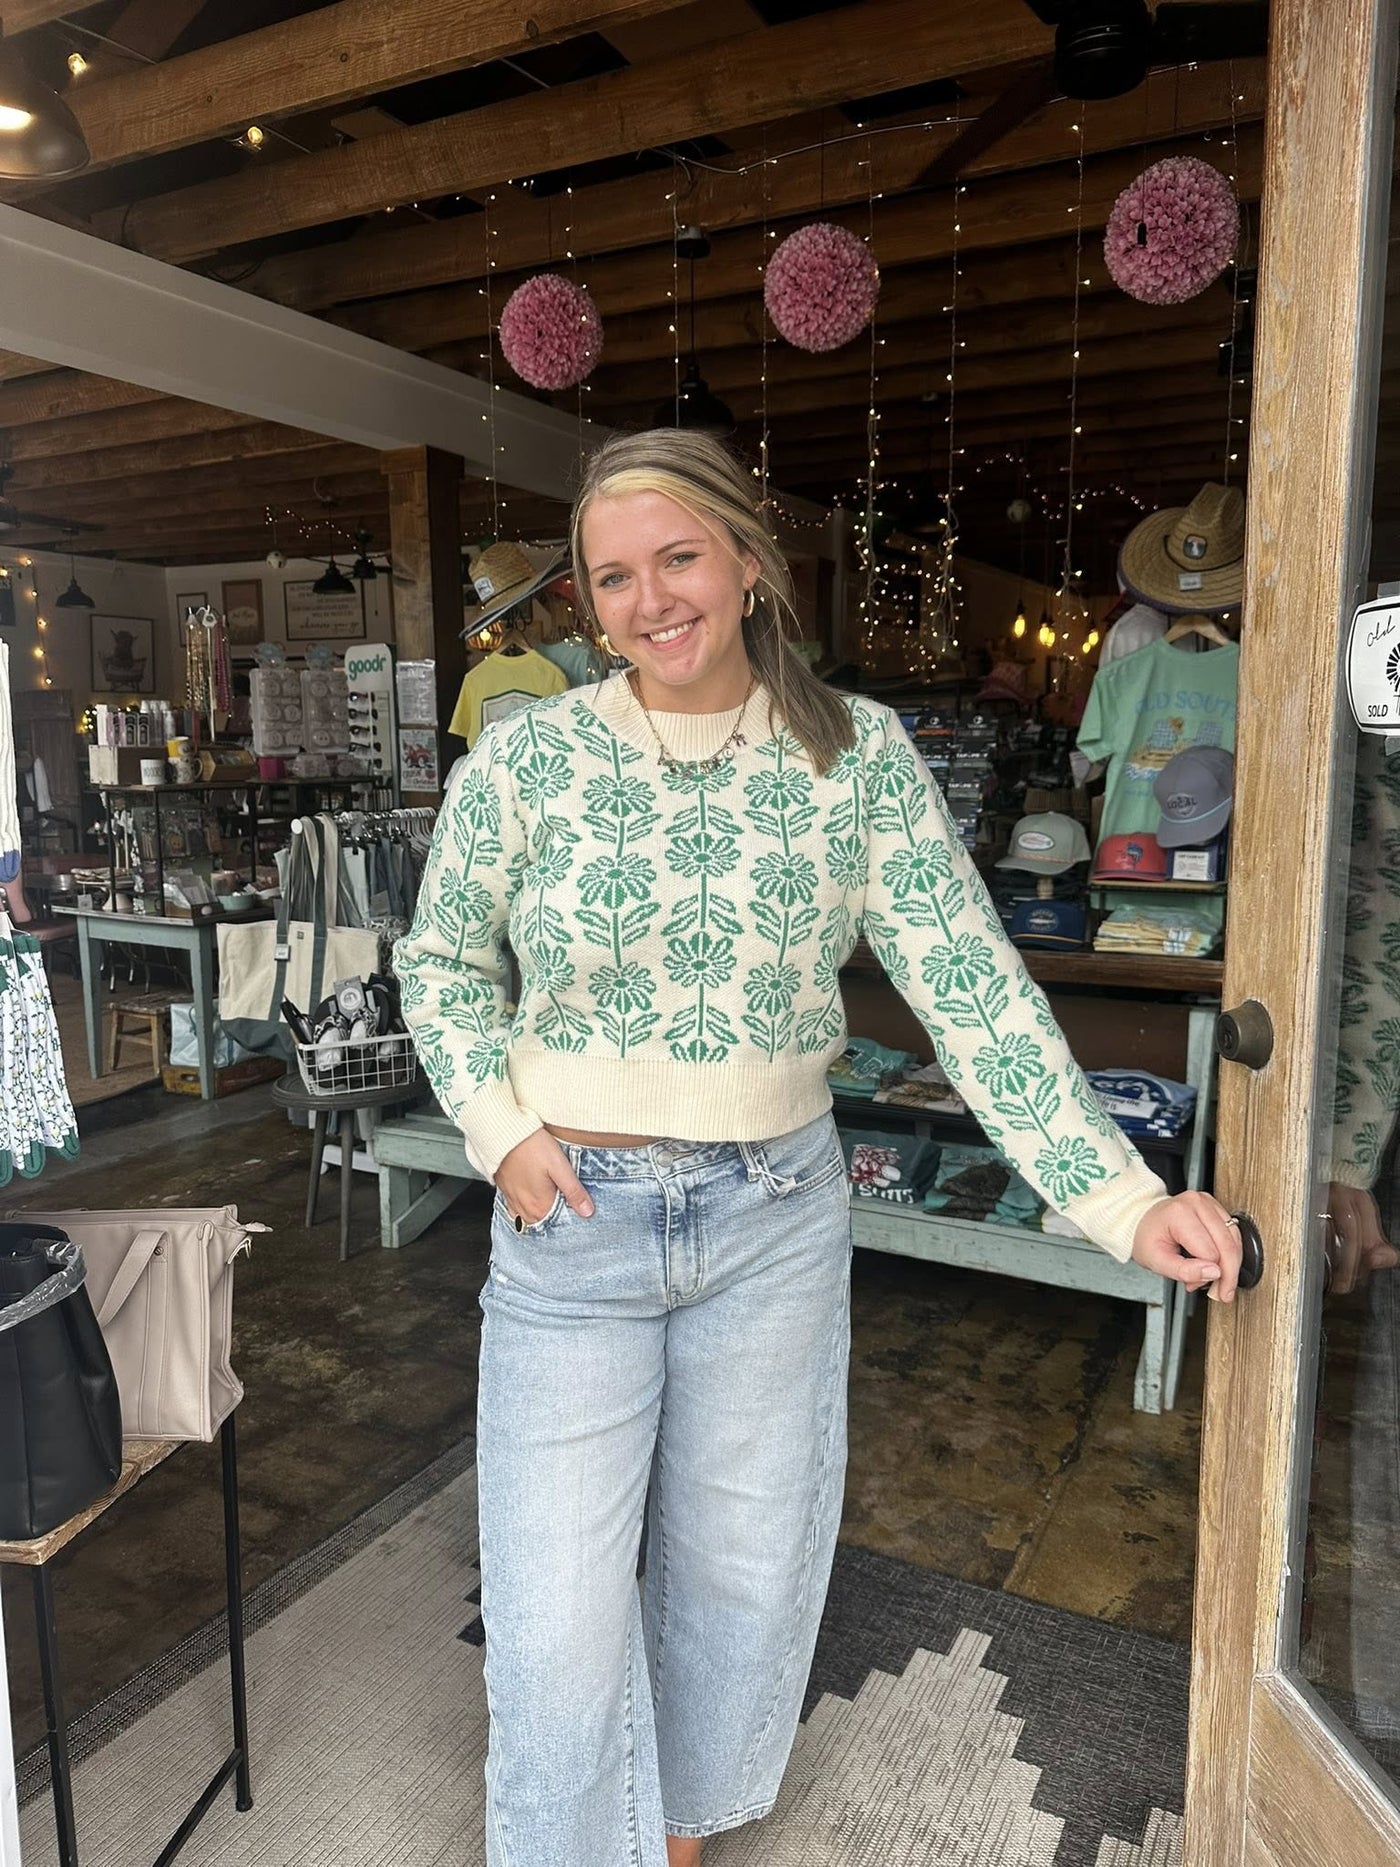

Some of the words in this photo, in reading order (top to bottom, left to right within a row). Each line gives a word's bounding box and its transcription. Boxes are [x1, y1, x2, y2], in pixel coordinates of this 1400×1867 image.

[348, 654, 386, 681] goodr
[1367, 704, 1388, 718] SOLD
[1166, 796, 1198, 809] LOCAL
